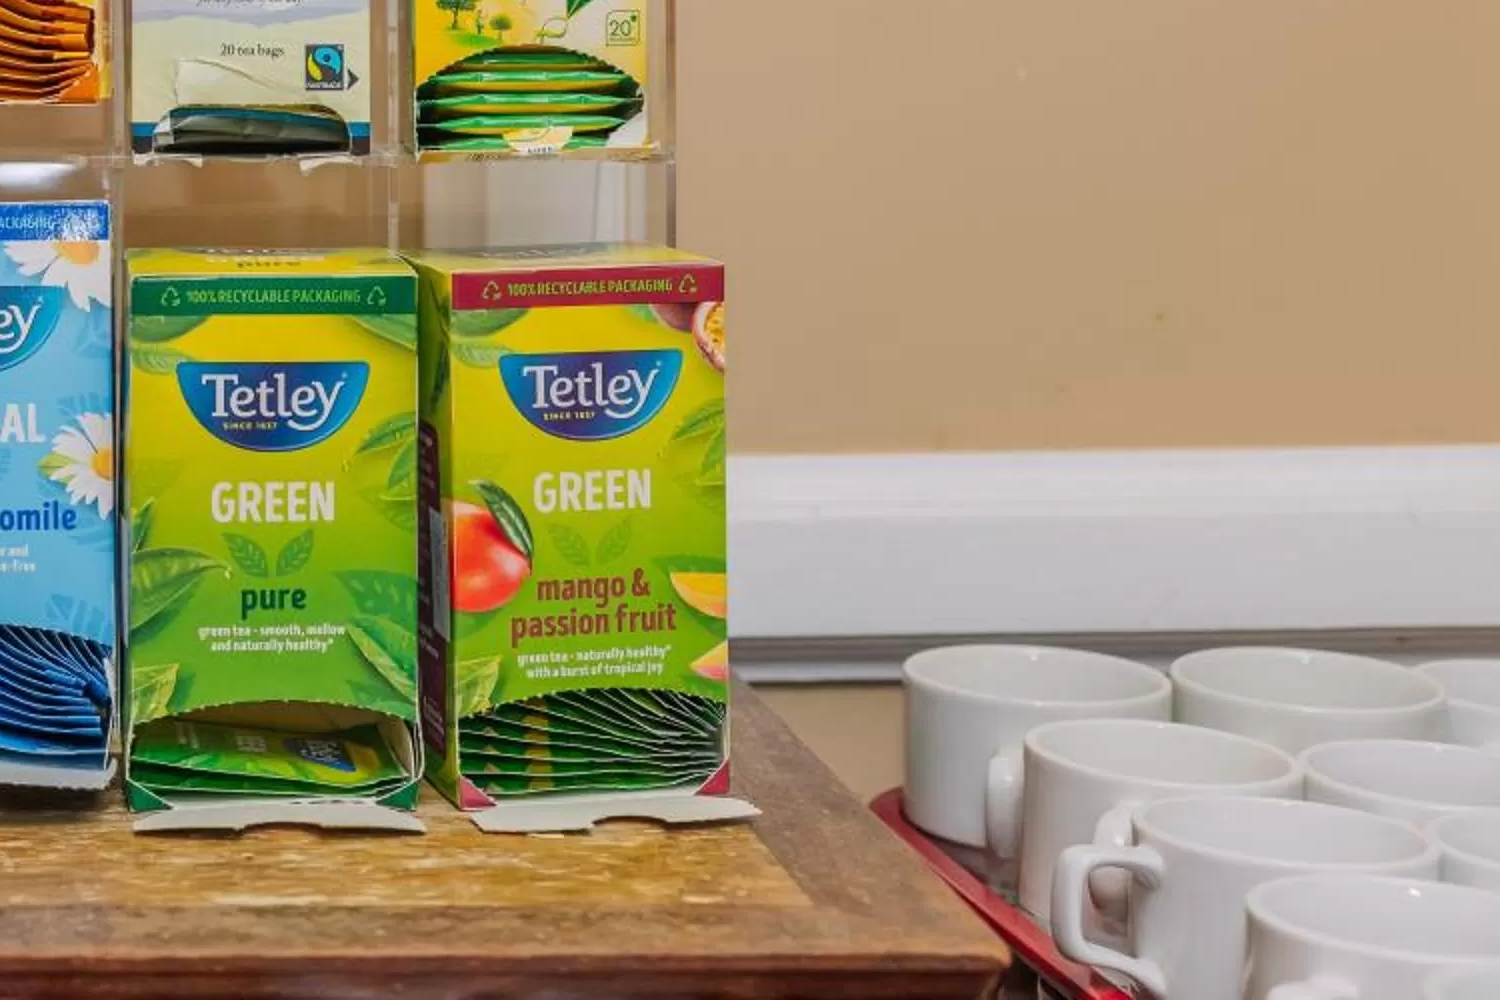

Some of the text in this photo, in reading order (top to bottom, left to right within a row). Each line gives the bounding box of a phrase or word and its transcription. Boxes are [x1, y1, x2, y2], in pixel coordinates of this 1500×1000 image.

[609, 19, 632, 38] 20
[219, 43, 285, 60] 20 tea bags
[186, 287, 361, 303] 100% RECYCLABLE PACKAGING
[507, 278, 673, 297] 100% RECYCLABLE PACKAGING
[522, 360, 660, 419] Tetley
[202, 371, 345, 432] Tetley
[543, 411, 571, 421] SINCE
[223, 421, 253, 431] SINCE
[533, 468, 652, 513] GREEN
[211, 480, 336, 524] GREEN
[537, 567, 650, 608] mango &
[241, 588, 307, 621] pure
[197, 625, 231, 641] green
[232, 625, 251, 637] tea
[511, 602, 677, 649] passion fruit
[211, 638, 231, 652] and
[233, 637, 284, 655] naturally
[517, 653, 549, 669] green
[550, 651, 569, 664] tea
[576, 647, 625, 663] naturally
[526, 664, 551, 679] with
[560, 663, 589, 678] burst
